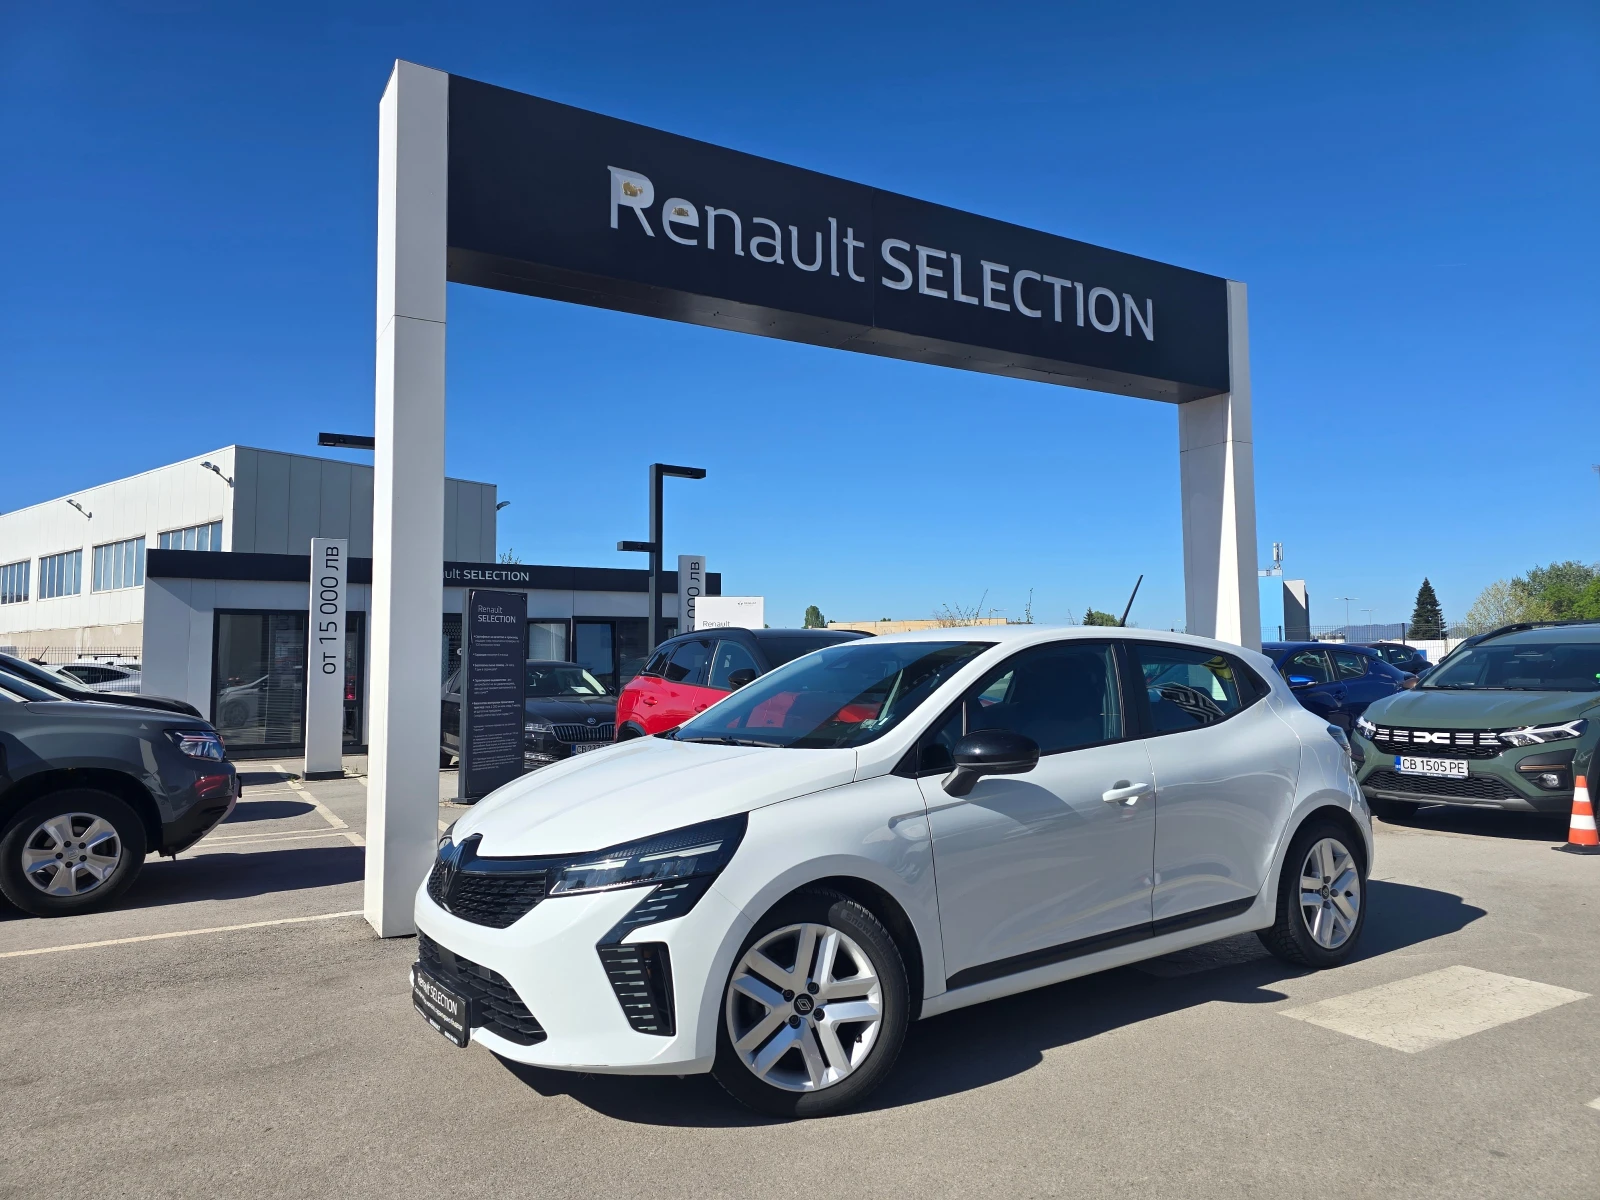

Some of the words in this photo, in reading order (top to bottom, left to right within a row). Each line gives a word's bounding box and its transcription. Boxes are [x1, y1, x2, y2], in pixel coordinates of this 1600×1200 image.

[607, 165, 865, 282] Renault
[880, 237, 1154, 342] SELECTION
[463, 569, 529, 581] SELECTION
[320, 576, 338, 614] 000
[477, 604, 503, 614] Renault
[477, 614, 516, 623] SELECTION
[702, 620, 731, 628] Renault
[319, 621, 337, 644] 15
[1402, 758, 1417, 769] CB
[1420, 759, 1447, 772] 1505
[1449, 761, 1465, 774] PE
[429, 985, 458, 1016] SELECTION
